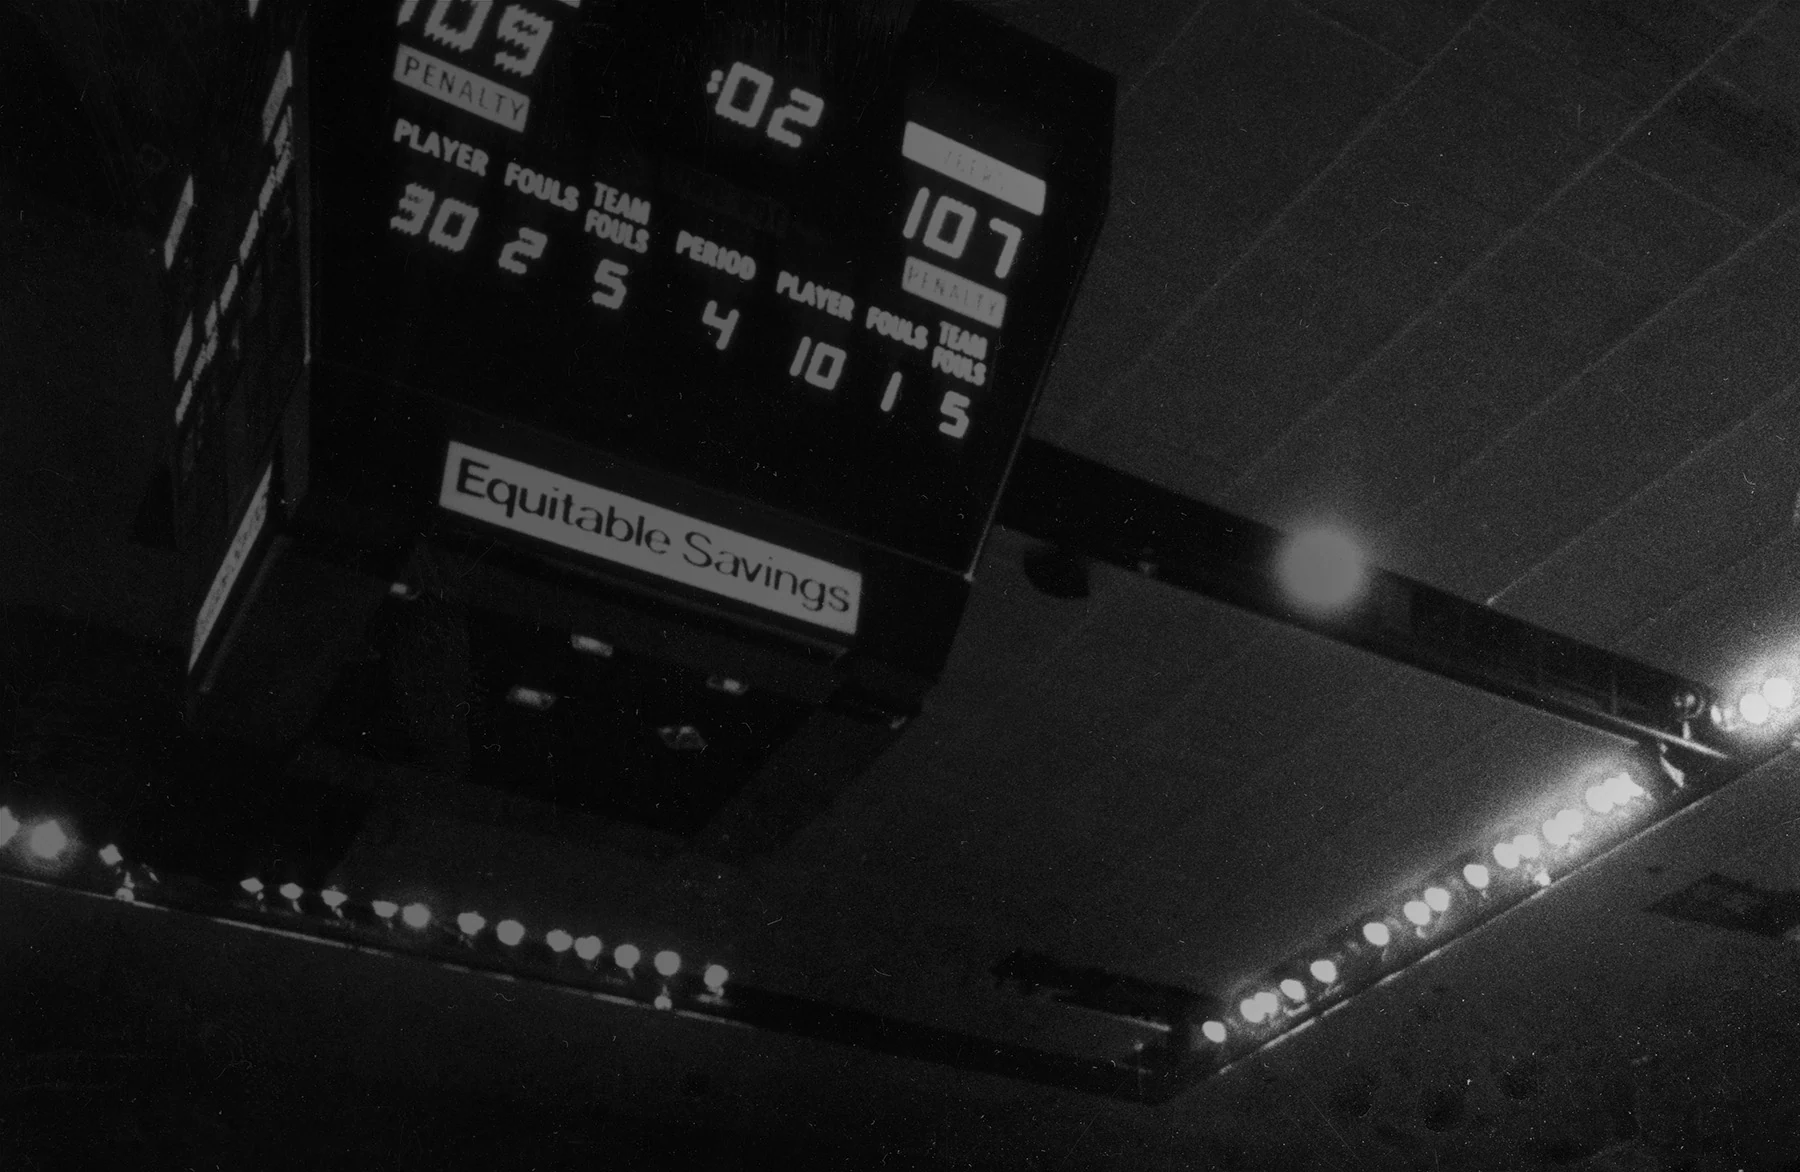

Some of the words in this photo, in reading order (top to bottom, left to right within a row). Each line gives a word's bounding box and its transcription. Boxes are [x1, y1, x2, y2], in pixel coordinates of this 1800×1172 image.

[403, 55, 525, 122] PENALTY
[393, 117, 490, 177] PLAYER
[503, 161, 580, 212] FOULS
[390, 182, 480, 253] 30
[594, 181, 651, 226] TEAM
[498, 226, 549, 275] 2
[584, 208, 650, 254] FOULS
[675, 229, 757, 281] PERIOD
[902, 186, 1023, 280] 107
[591, 258, 630, 311] 5
[776, 270, 855, 322] PLAYER
[865, 305, 929, 351] FOULS
[701, 299, 740, 351] 4
[938, 320, 989, 361] TEAM
[788, 335, 848, 391] 10
[931, 345, 988, 387] FOULS
[879, 370, 903, 413] 1
[938, 390, 972, 440] 5
[456, 457, 672, 556] Equitable
[682, 530, 852, 614] Savings
